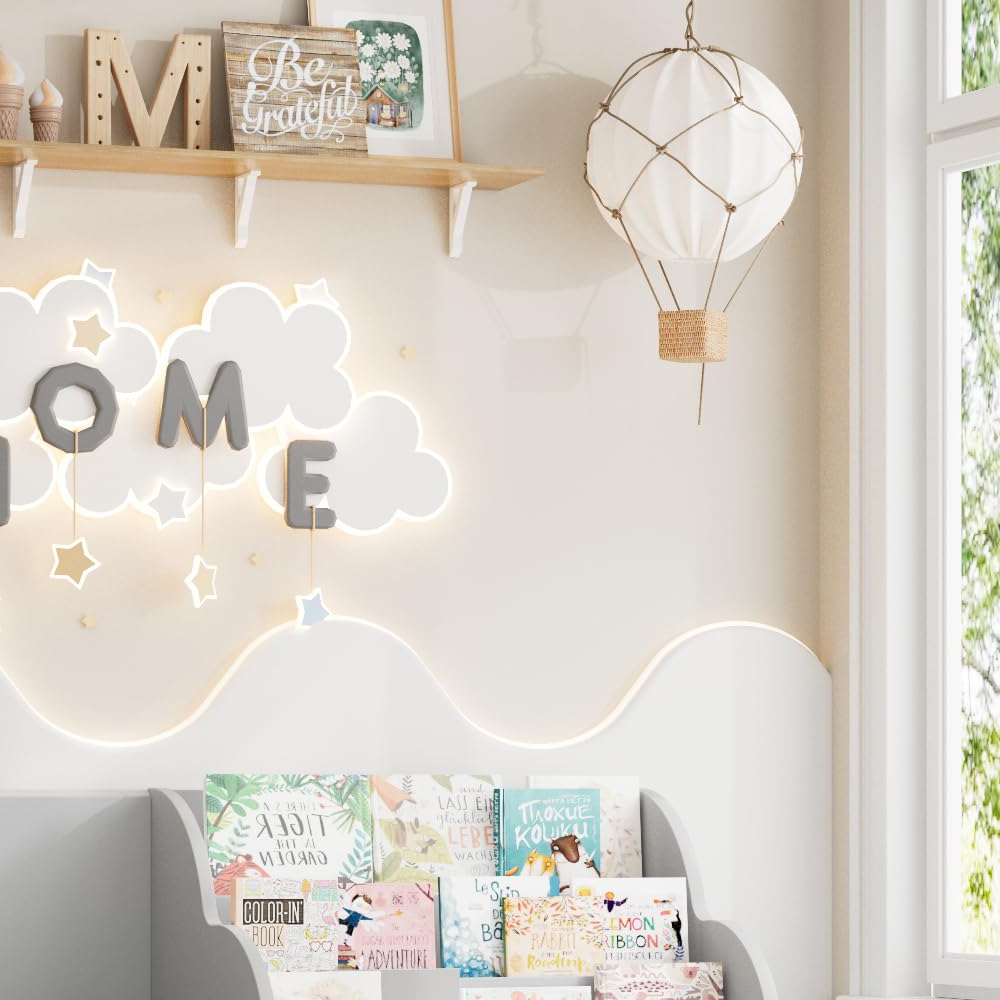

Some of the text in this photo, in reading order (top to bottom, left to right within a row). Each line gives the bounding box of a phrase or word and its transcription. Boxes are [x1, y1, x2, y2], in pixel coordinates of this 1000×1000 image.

[248, 36, 334, 92] Be
[241, 75, 358, 143] Grateful
[446, 824, 494, 849] LEBE
[252, 925, 284, 947] BOOK
[602, 934, 659, 949] RIBBON
[367, 949, 428, 970] ADVENTURE
